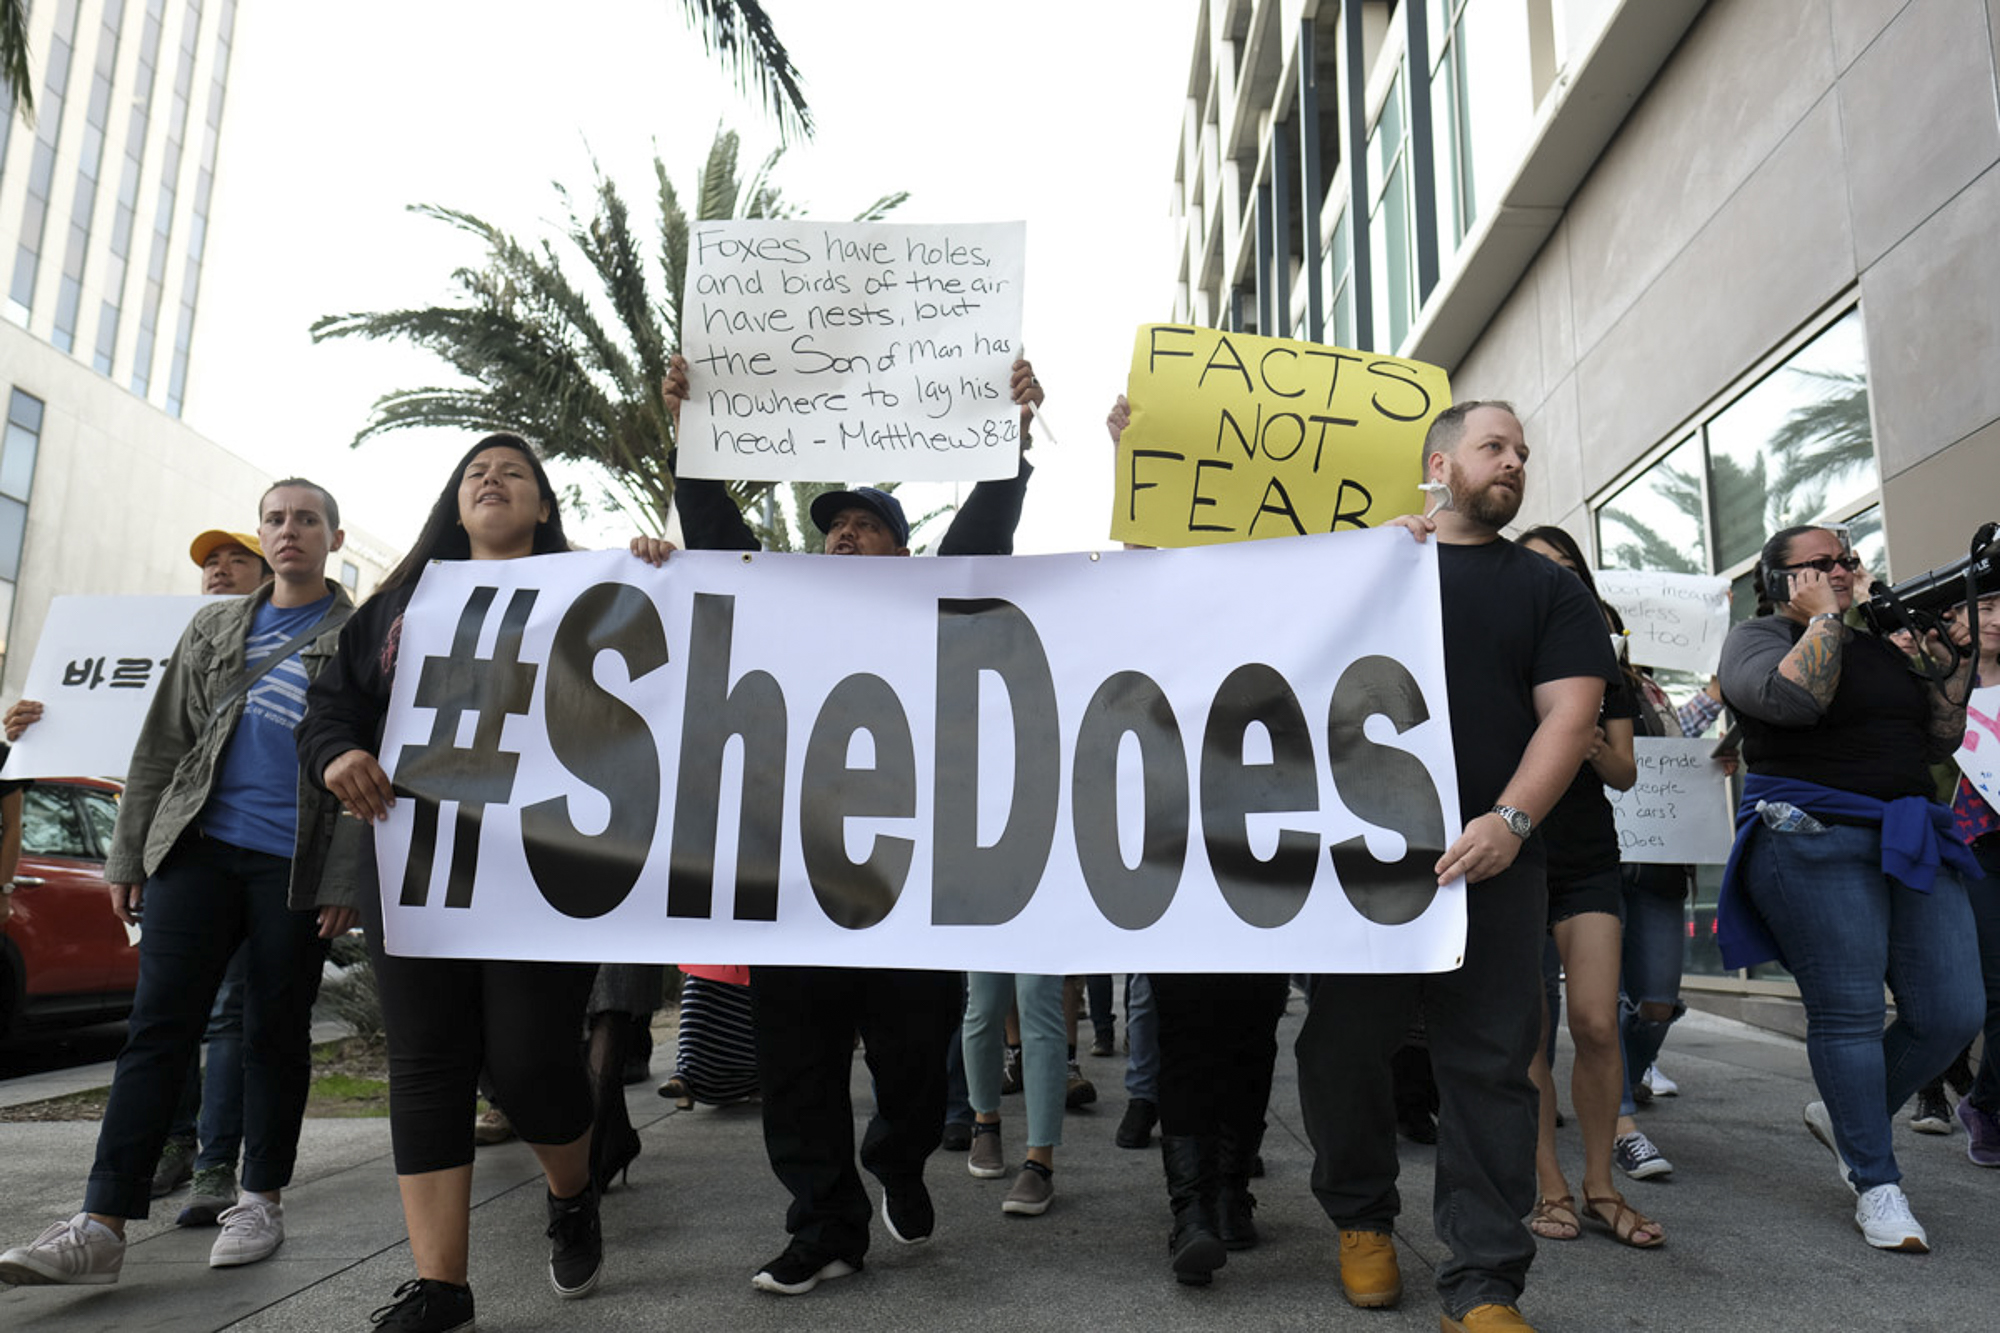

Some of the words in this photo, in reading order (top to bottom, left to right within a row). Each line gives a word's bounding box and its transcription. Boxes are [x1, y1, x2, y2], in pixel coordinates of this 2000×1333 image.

[697, 230, 811, 266] Foxes
[824, 230, 896, 264] have
[906, 237, 991, 268] holes,
[697, 269, 764, 296] and
[781, 269, 851, 295] birds
[864, 270, 897, 295] of
[906, 271, 966, 295] the
[971, 278, 1009, 295] air
[703, 303, 795, 335] have
[808, 303, 905, 330] nests,
[915, 299, 981, 321] but
[695, 344, 777, 377] the
[791, 334, 870, 377] Son
[877, 342, 901, 373] of
[909, 340, 963, 365] Man
[975, 332, 1010, 355] has
[1150, 327, 1430, 422] FACTS
[709, 388, 848, 417] nowhere
[861, 382, 899, 408] to
[915, 375, 952, 420] lay
[960, 375, 999, 400] his
[712, 423, 797, 456] head
[839, 420, 981, 451] Matthew
[1217, 404, 1359, 473] NOT
[1130, 450, 1373, 537] FEAR
[62, 656, 171, 691] 바르
[392, 582, 1444, 931] #SheDoes
[1635, 752, 1657, 769] he
[1659, 753, 1702, 775] pride
[1636, 802, 1677, 819] cars?
[1620, 829, 1666, 849] Does
